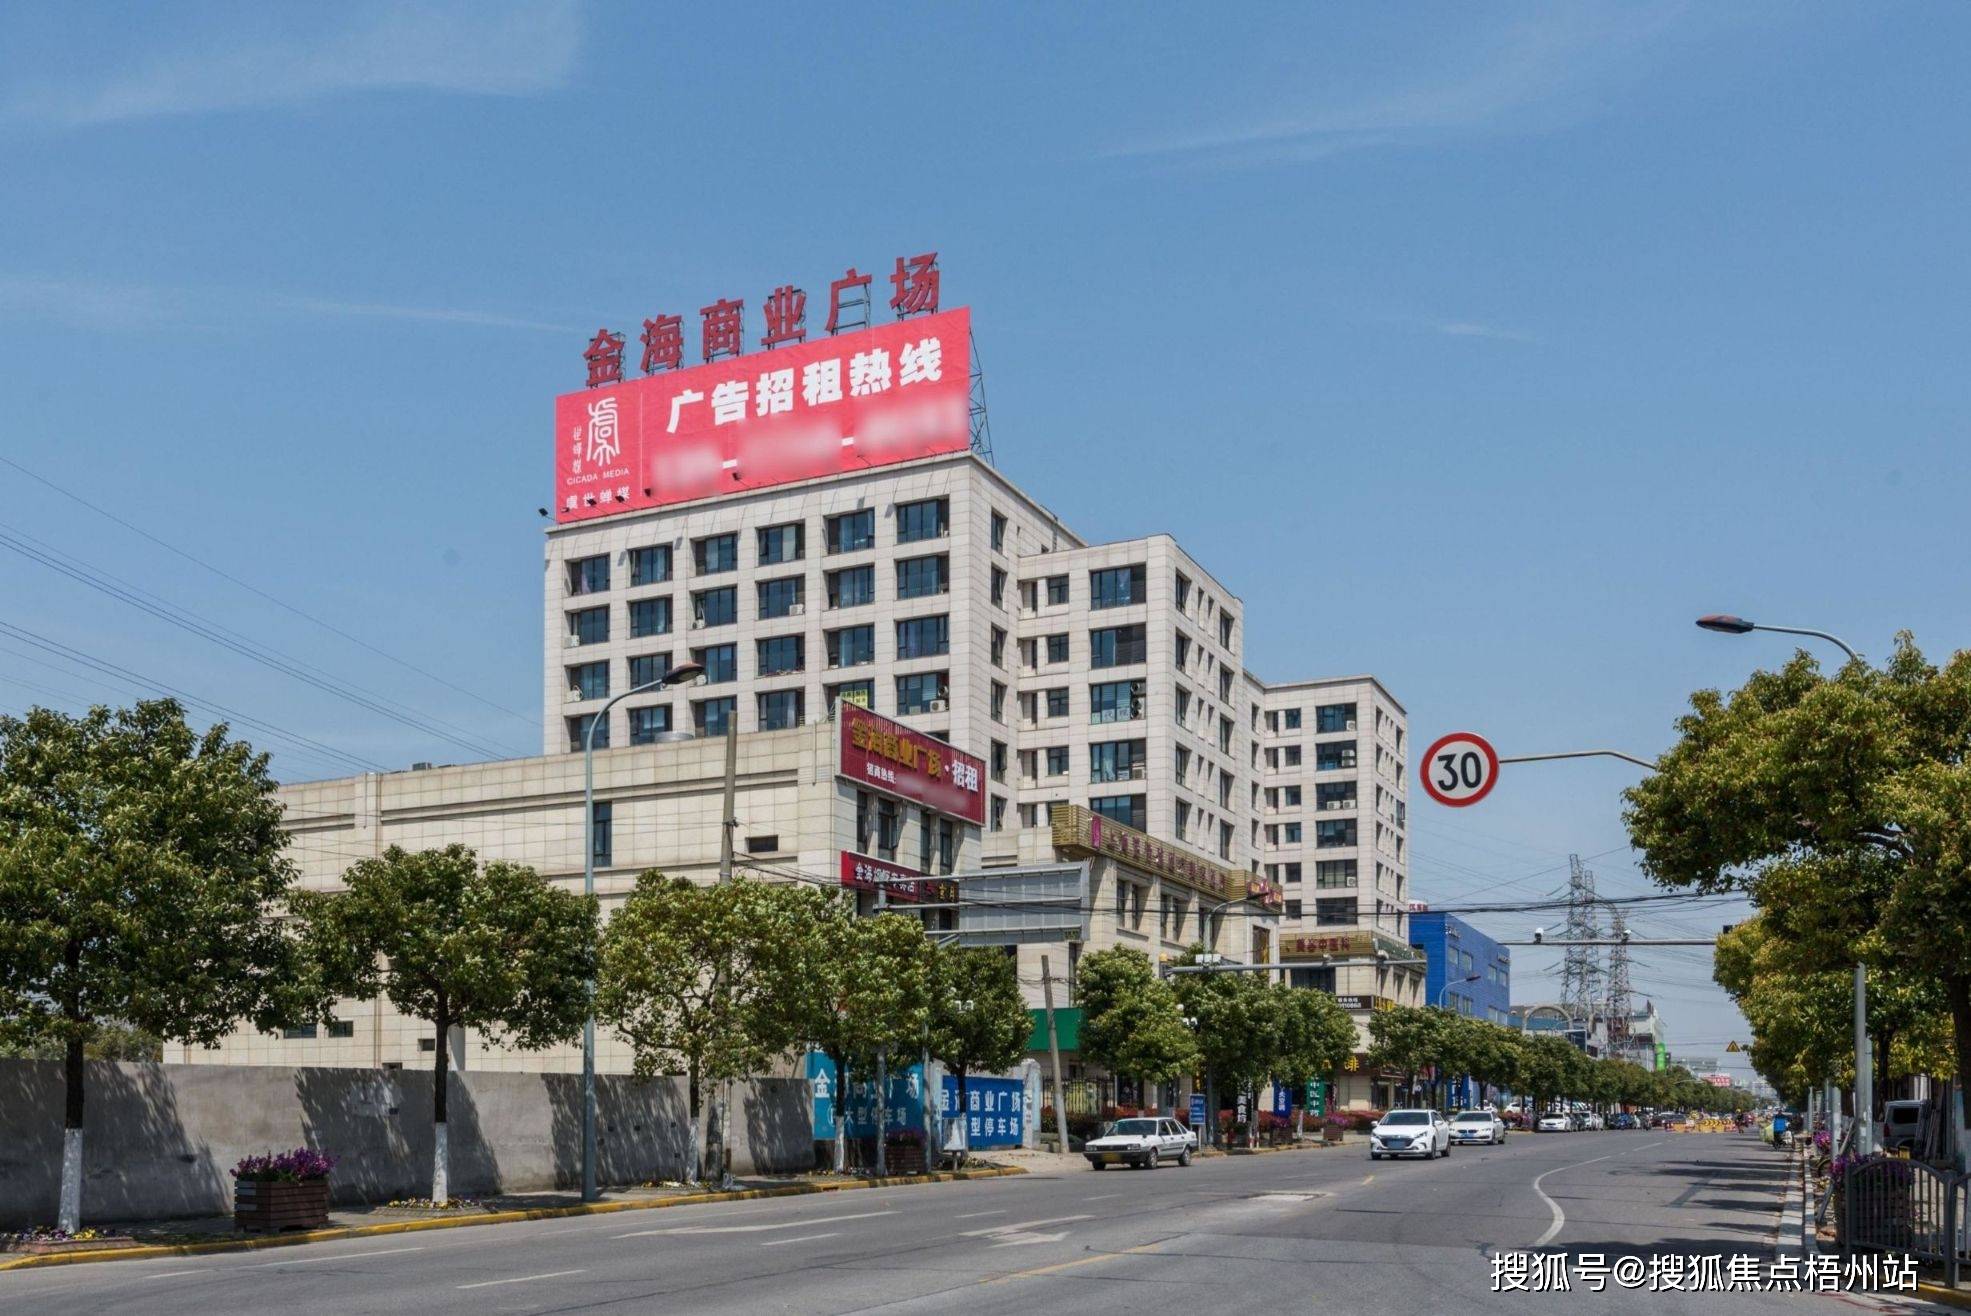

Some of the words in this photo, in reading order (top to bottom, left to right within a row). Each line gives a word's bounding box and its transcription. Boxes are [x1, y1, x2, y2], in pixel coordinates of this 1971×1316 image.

[583, 251, 941, 386] 金海商业广场
[666, 337, 943, 433] 广告招租热线
[566, 473, 598, 486] CICADA
[602, 467, 630, 480] MEDIA
[1437, 751, 1482, 792] 30
